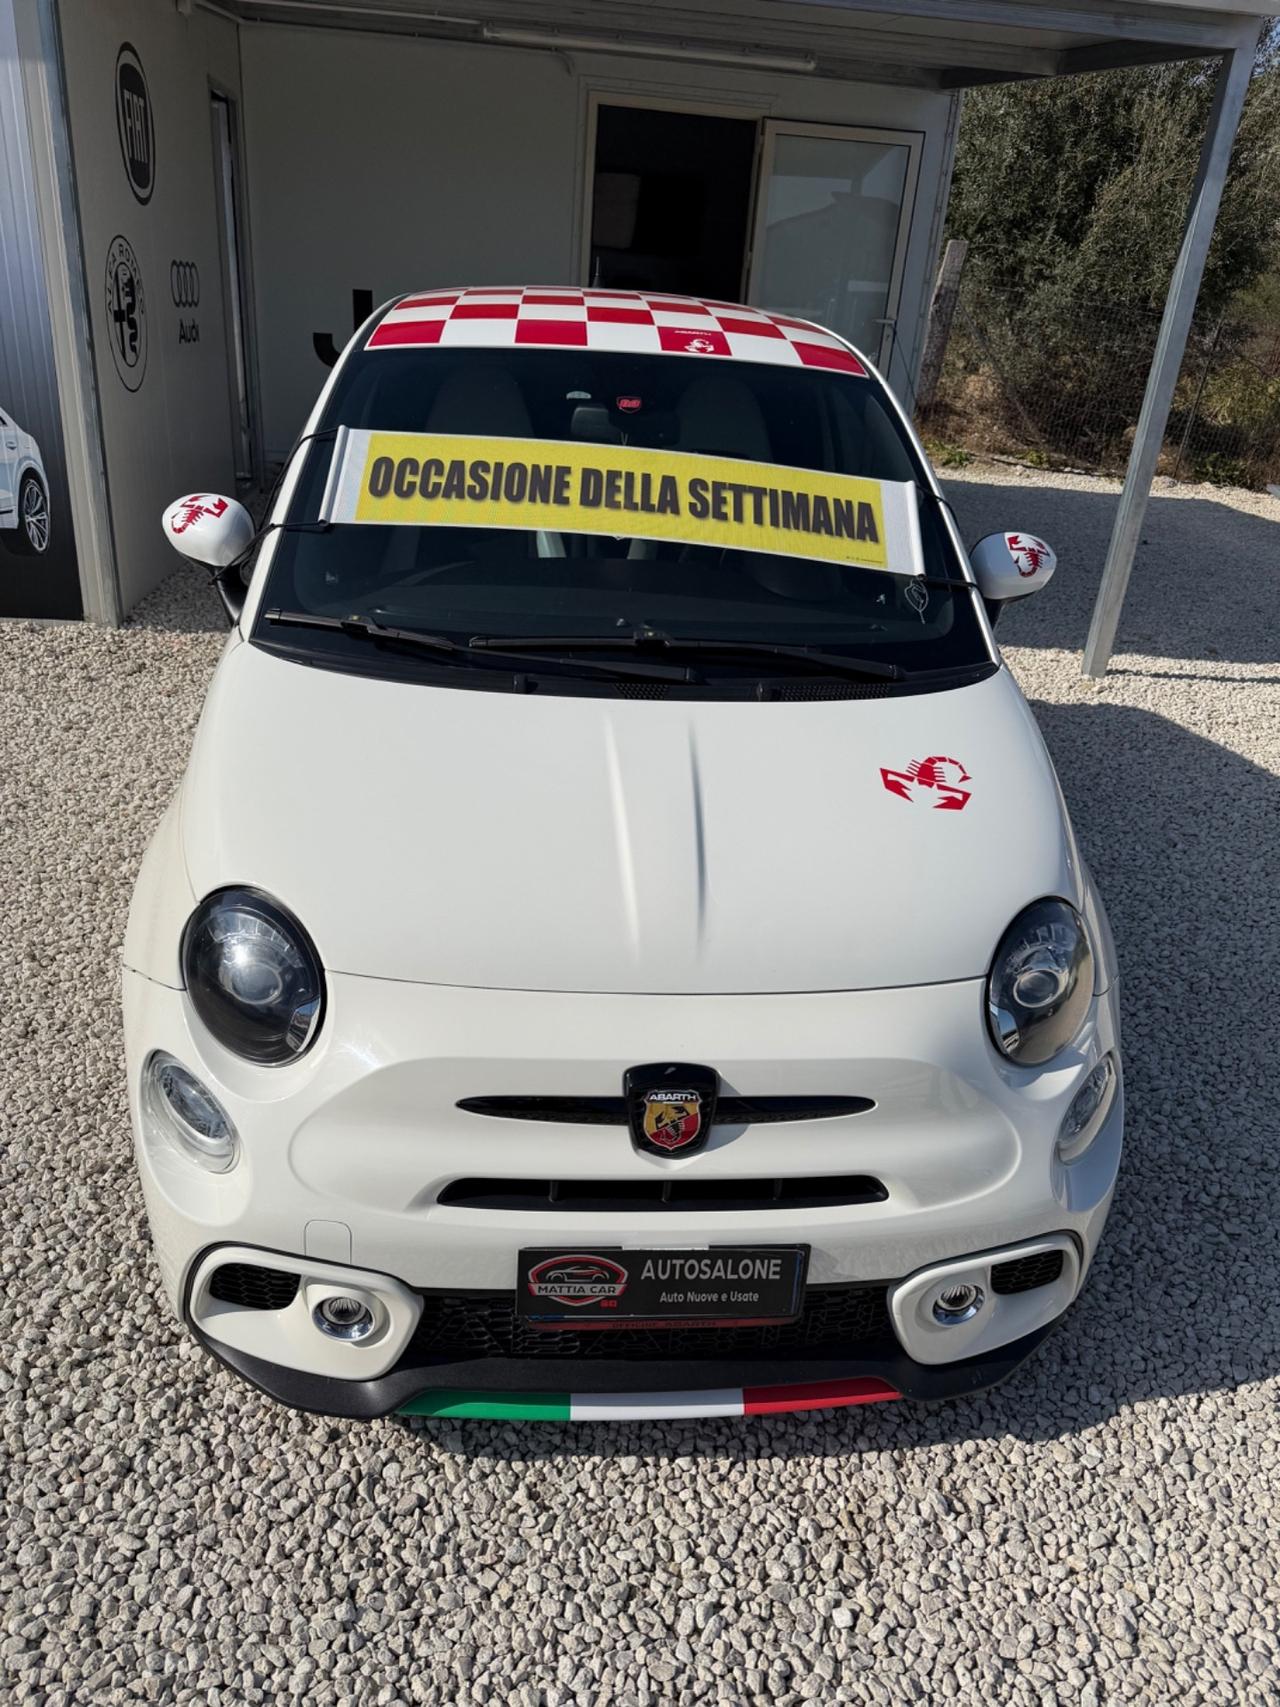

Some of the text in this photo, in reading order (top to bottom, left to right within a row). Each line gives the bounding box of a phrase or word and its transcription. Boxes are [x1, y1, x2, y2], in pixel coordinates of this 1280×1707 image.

[123, 88, 149, 164] FIAT
[178, 318, 200, 345] Audi
[368, 455, 879, 544] OCCASIONE DELLA SETTIMANA
[649, 1093, 696, 1101] ABARTH
[640, 1258, 782, 1280] AUTOSALONE
[537, 1285, 617, 1294] MATTIA CAR
[660, 1290, 760, 1303] Auto Nuove e Usate
